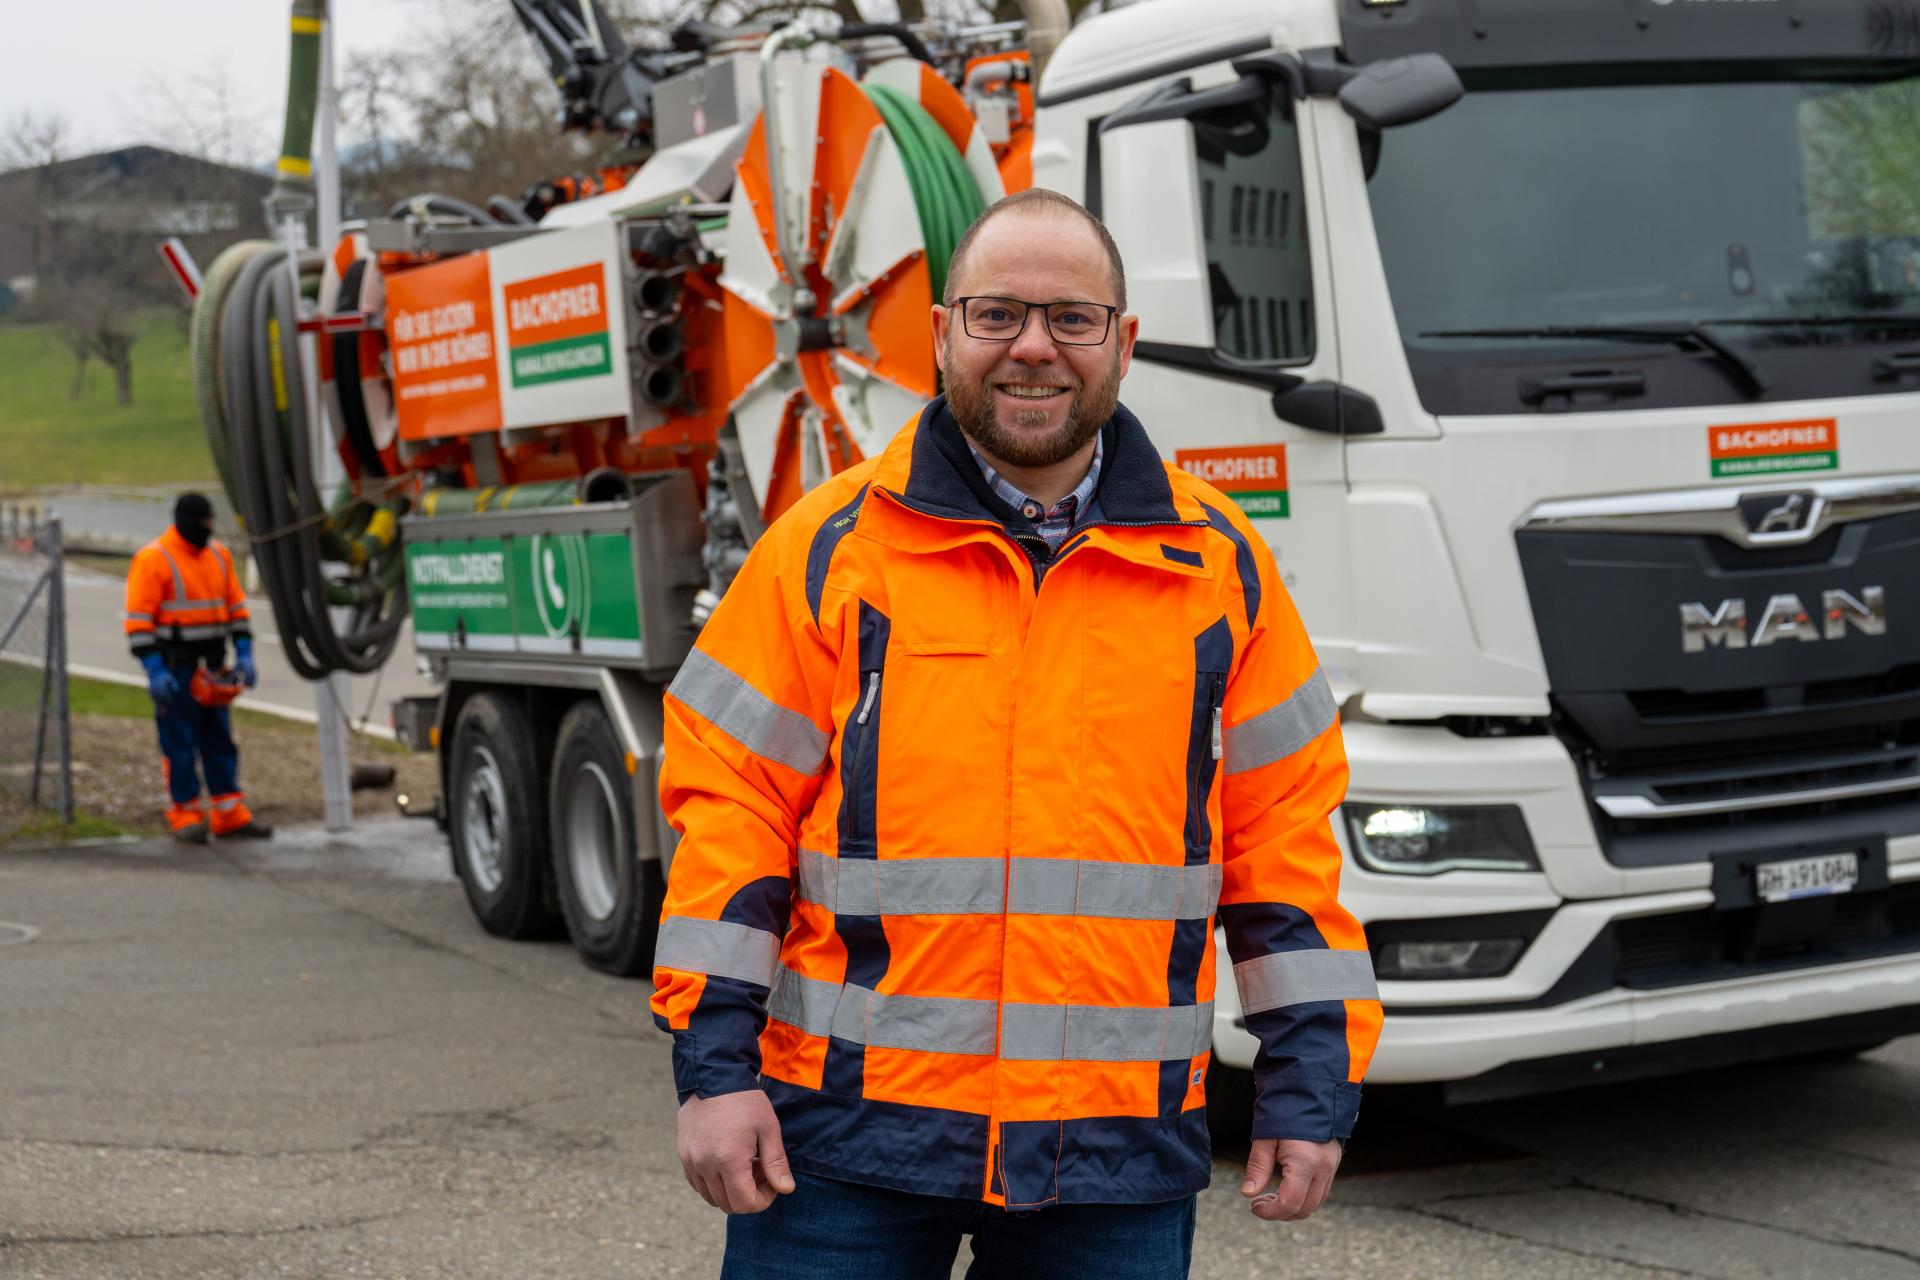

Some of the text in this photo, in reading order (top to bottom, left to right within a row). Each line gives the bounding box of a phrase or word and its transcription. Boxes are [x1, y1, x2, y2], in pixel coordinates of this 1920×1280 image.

[511, 284, 600, 331] BACHOFNER
[1717, 426, 1828, 450] BACHOFNER
[1679, 586, 1887, 653] MAN
